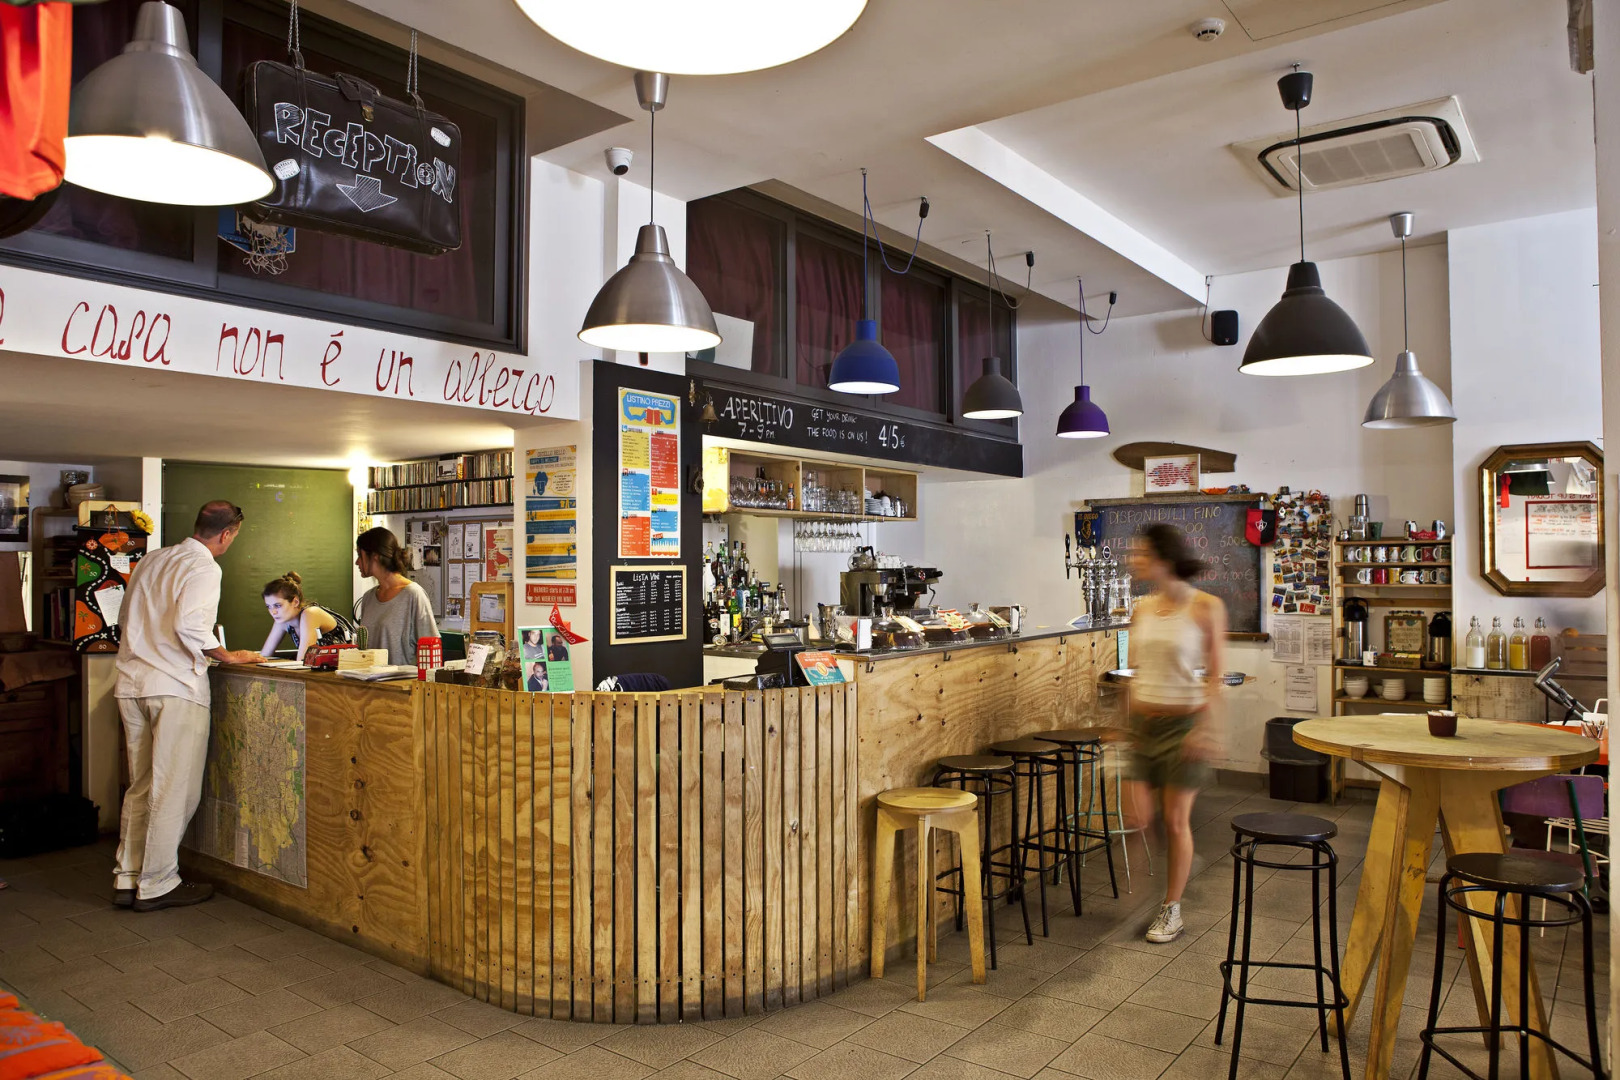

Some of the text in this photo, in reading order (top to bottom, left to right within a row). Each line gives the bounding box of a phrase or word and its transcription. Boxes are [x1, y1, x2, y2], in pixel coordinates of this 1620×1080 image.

[61, 301, 171, 366] casa
[216, 322, 285, 381] non
[376, 350, 414, 397] un
[626, 394, 671, 408] LISTINO PREZZI
[720, 396, 794, 429] APERITIVO
[811, 408, 824, 421] GET
[826, 410, 840, 422] YOUR
[806, 426, 819, 437] THE
[822, 427, 837, 439] FOOD
[839, 429, 845, 439] IS
[847, 431, 855, 440] ON
[878, 424, 899, 449] 4/5
[1108, 506, 1222, 525] DISPONIBILI FINO
[632, 573, 649, 582] LISTA
